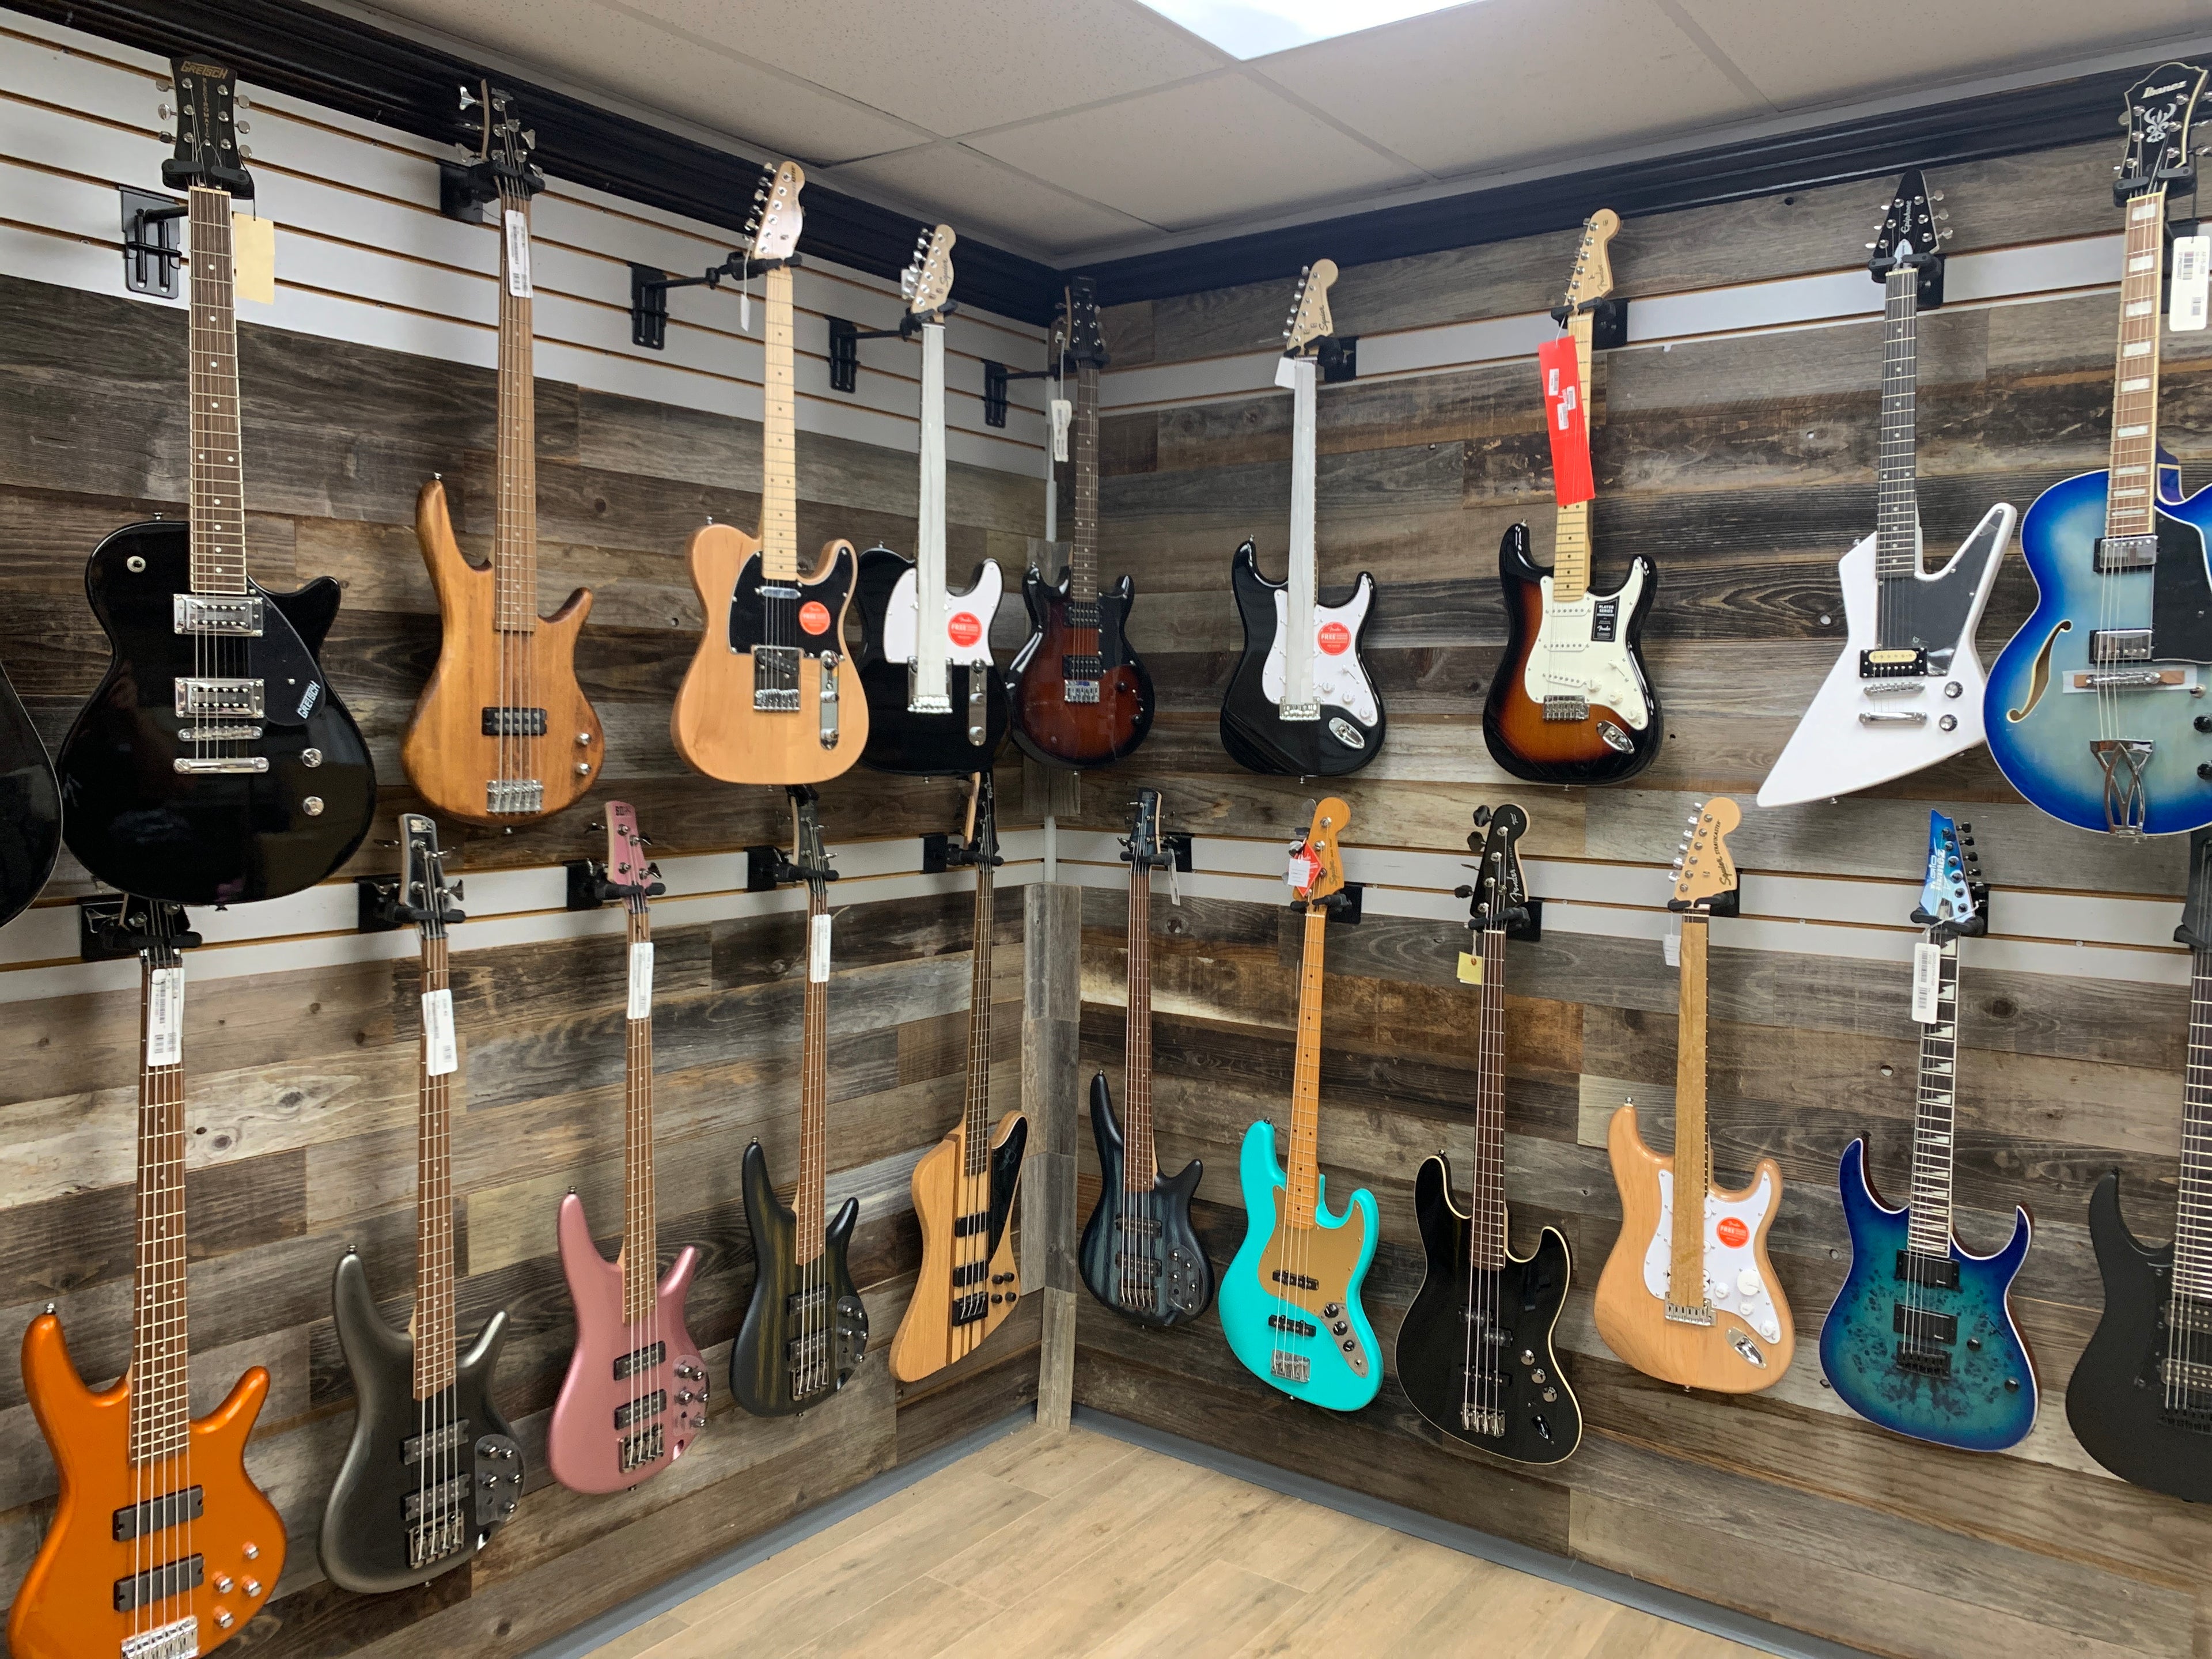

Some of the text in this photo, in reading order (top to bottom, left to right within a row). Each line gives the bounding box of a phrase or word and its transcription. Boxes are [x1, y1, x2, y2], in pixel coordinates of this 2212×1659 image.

[180, 60, 228, 79] GRETSCH
[2141, 80, 2187, 99] Ibanez
[1900, 200, 1912, 234] Epiphone
[939, 258, 952, 287] Squier
[1319, 304, 1330, 331] Squier
[951, 623, 966, 631] FREE
[296, 680, 321, 719] GRETSCH
[1713, 820, 1732, 886] Squier STRATOCASTER
[1930, 849, 1946, 891] Ibanez
[1506, 868, 1523, 903] Fender
[1719, 1225, 1734, 1234] FREE
